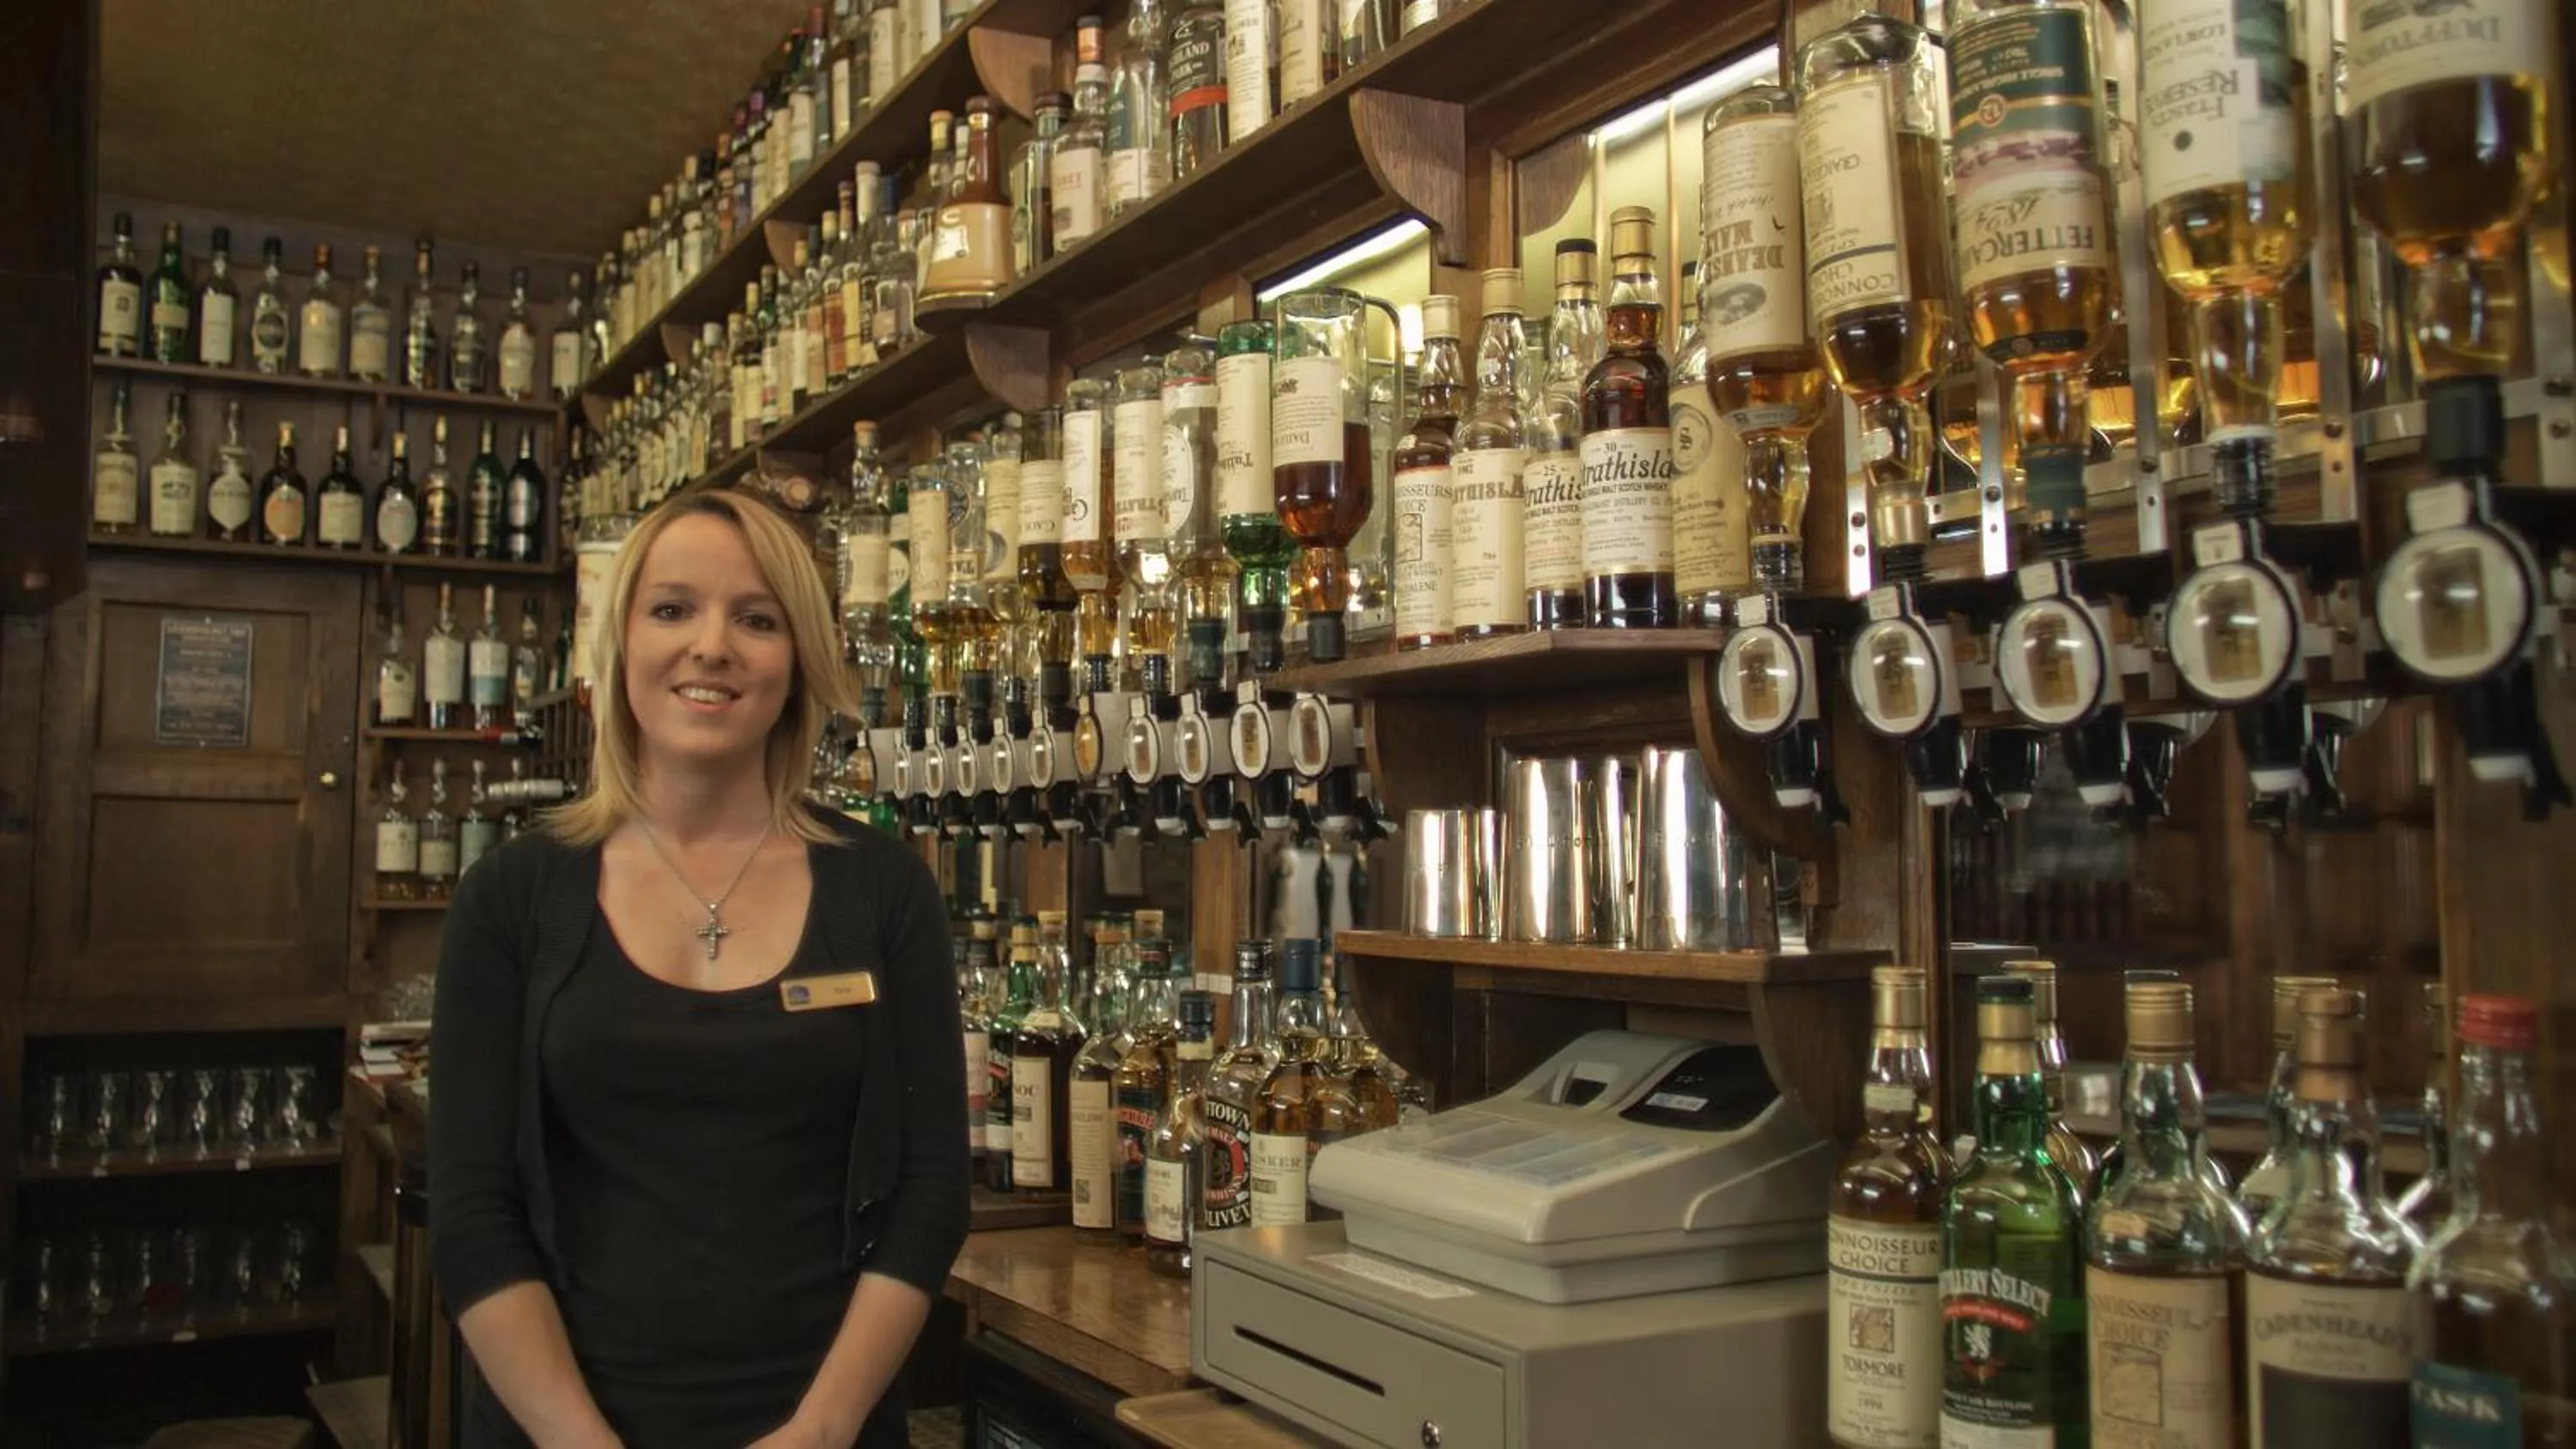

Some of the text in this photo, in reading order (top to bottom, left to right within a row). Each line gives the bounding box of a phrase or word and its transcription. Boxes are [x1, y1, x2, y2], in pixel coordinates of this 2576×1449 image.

[1840, 1251, 1910, 1274] CHOICE
[1990, 1267, 2050, 1318] SELECT
[1842, 1353, 1906, 1379] TORMORE
